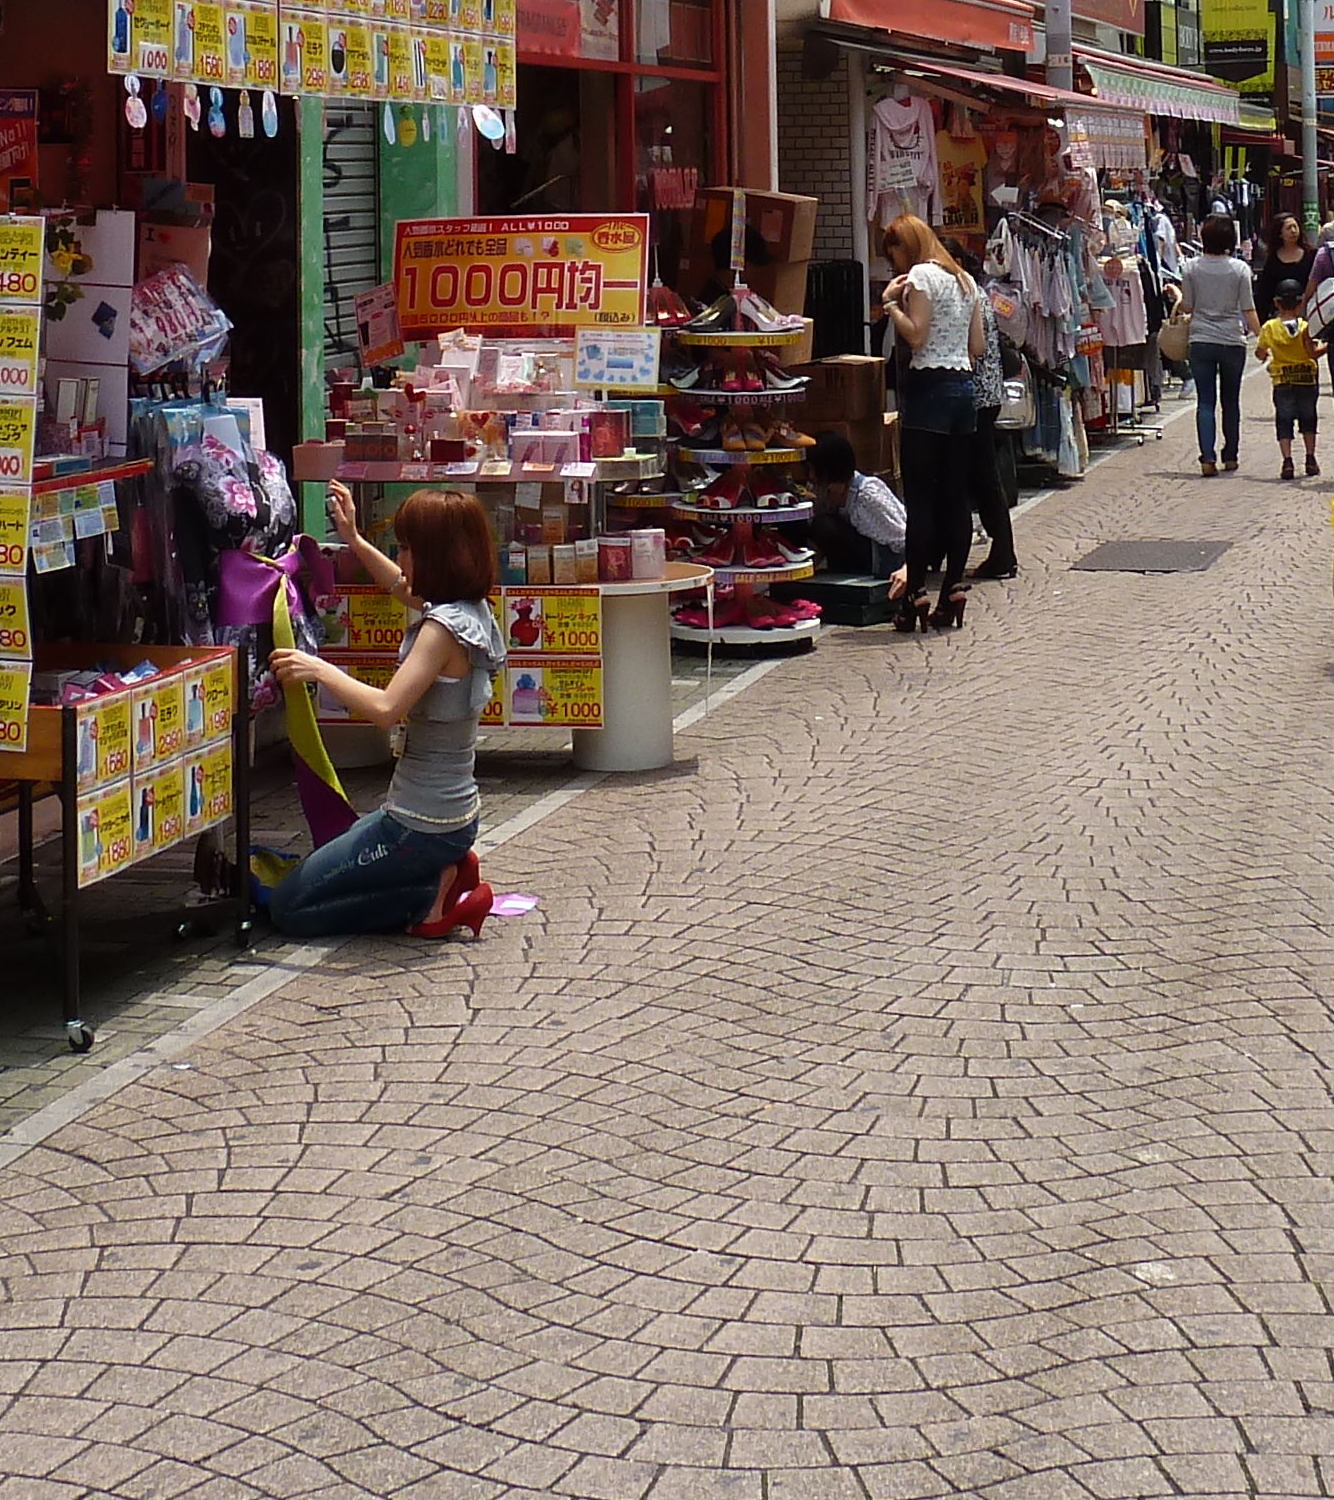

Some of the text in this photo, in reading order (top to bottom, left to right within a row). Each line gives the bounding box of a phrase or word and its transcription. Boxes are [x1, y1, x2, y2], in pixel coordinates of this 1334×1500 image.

[404, 260, 639, 311] 1000円均一
[546, 613, 577, 621] トーリーン
[351, 628, 404, 644] ¥1000
[545, 631, 598, 646] ¥1000
[548, 702, 601, 717] ¥1000
